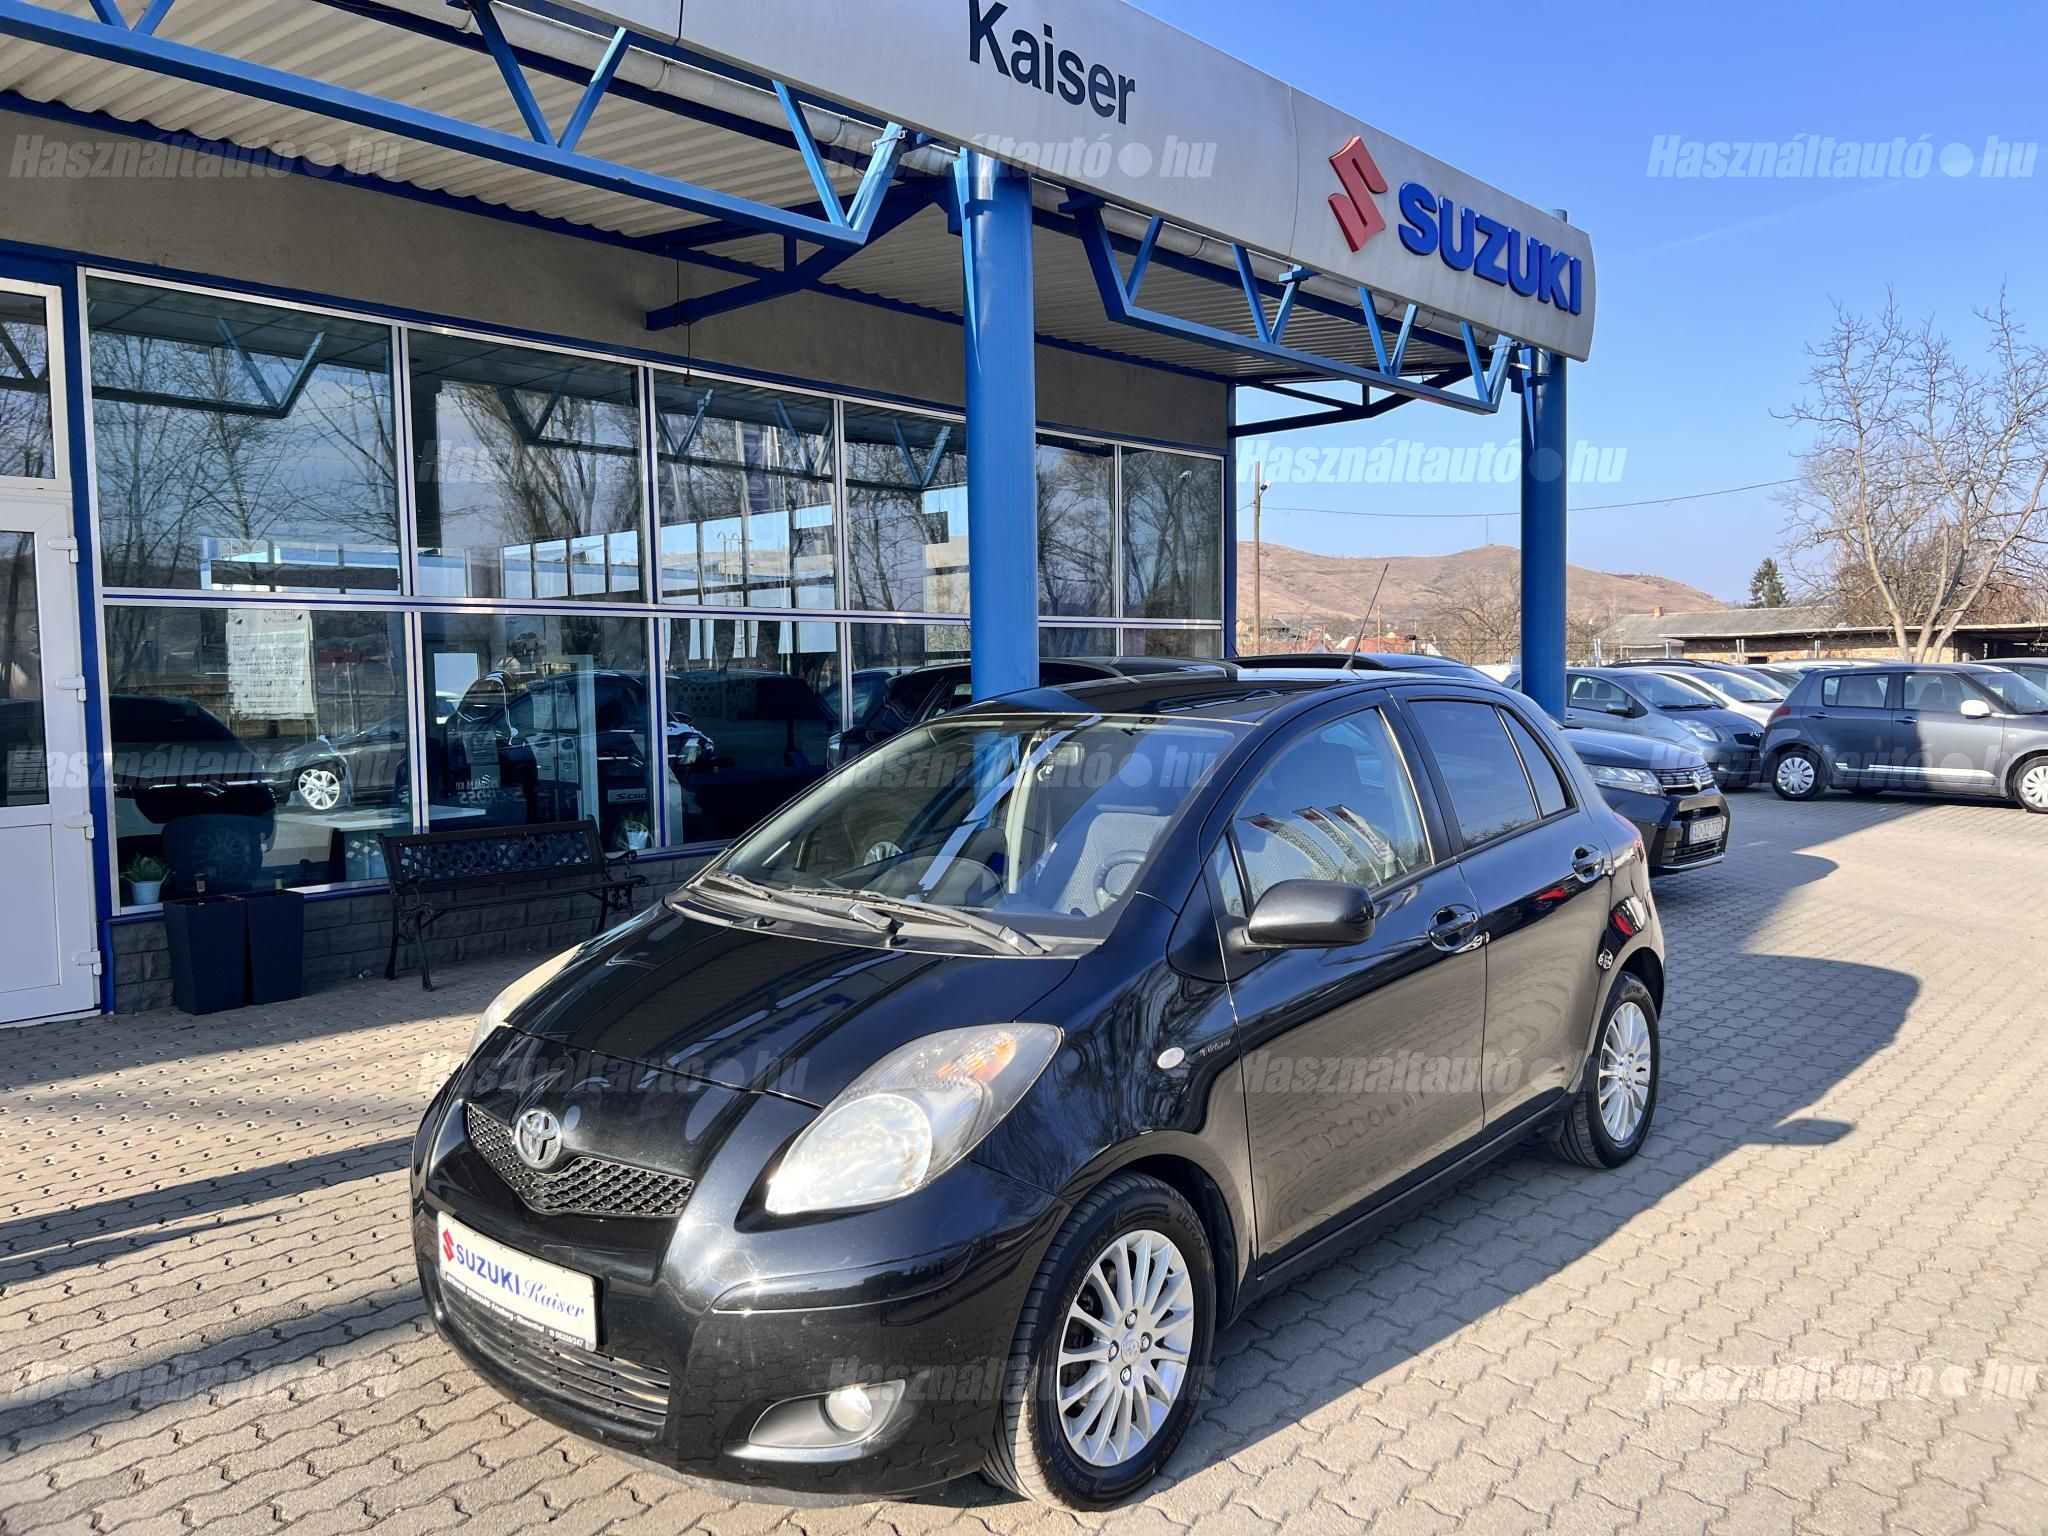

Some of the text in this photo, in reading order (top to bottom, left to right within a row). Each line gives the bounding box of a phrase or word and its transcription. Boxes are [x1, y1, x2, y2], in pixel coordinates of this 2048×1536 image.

[967, 0, 1136, 125] Kaiser
[1398, 182, 1583, 315] SUZUKI
[456, 1243, 586, 1319] SUZUKI Kaiser
